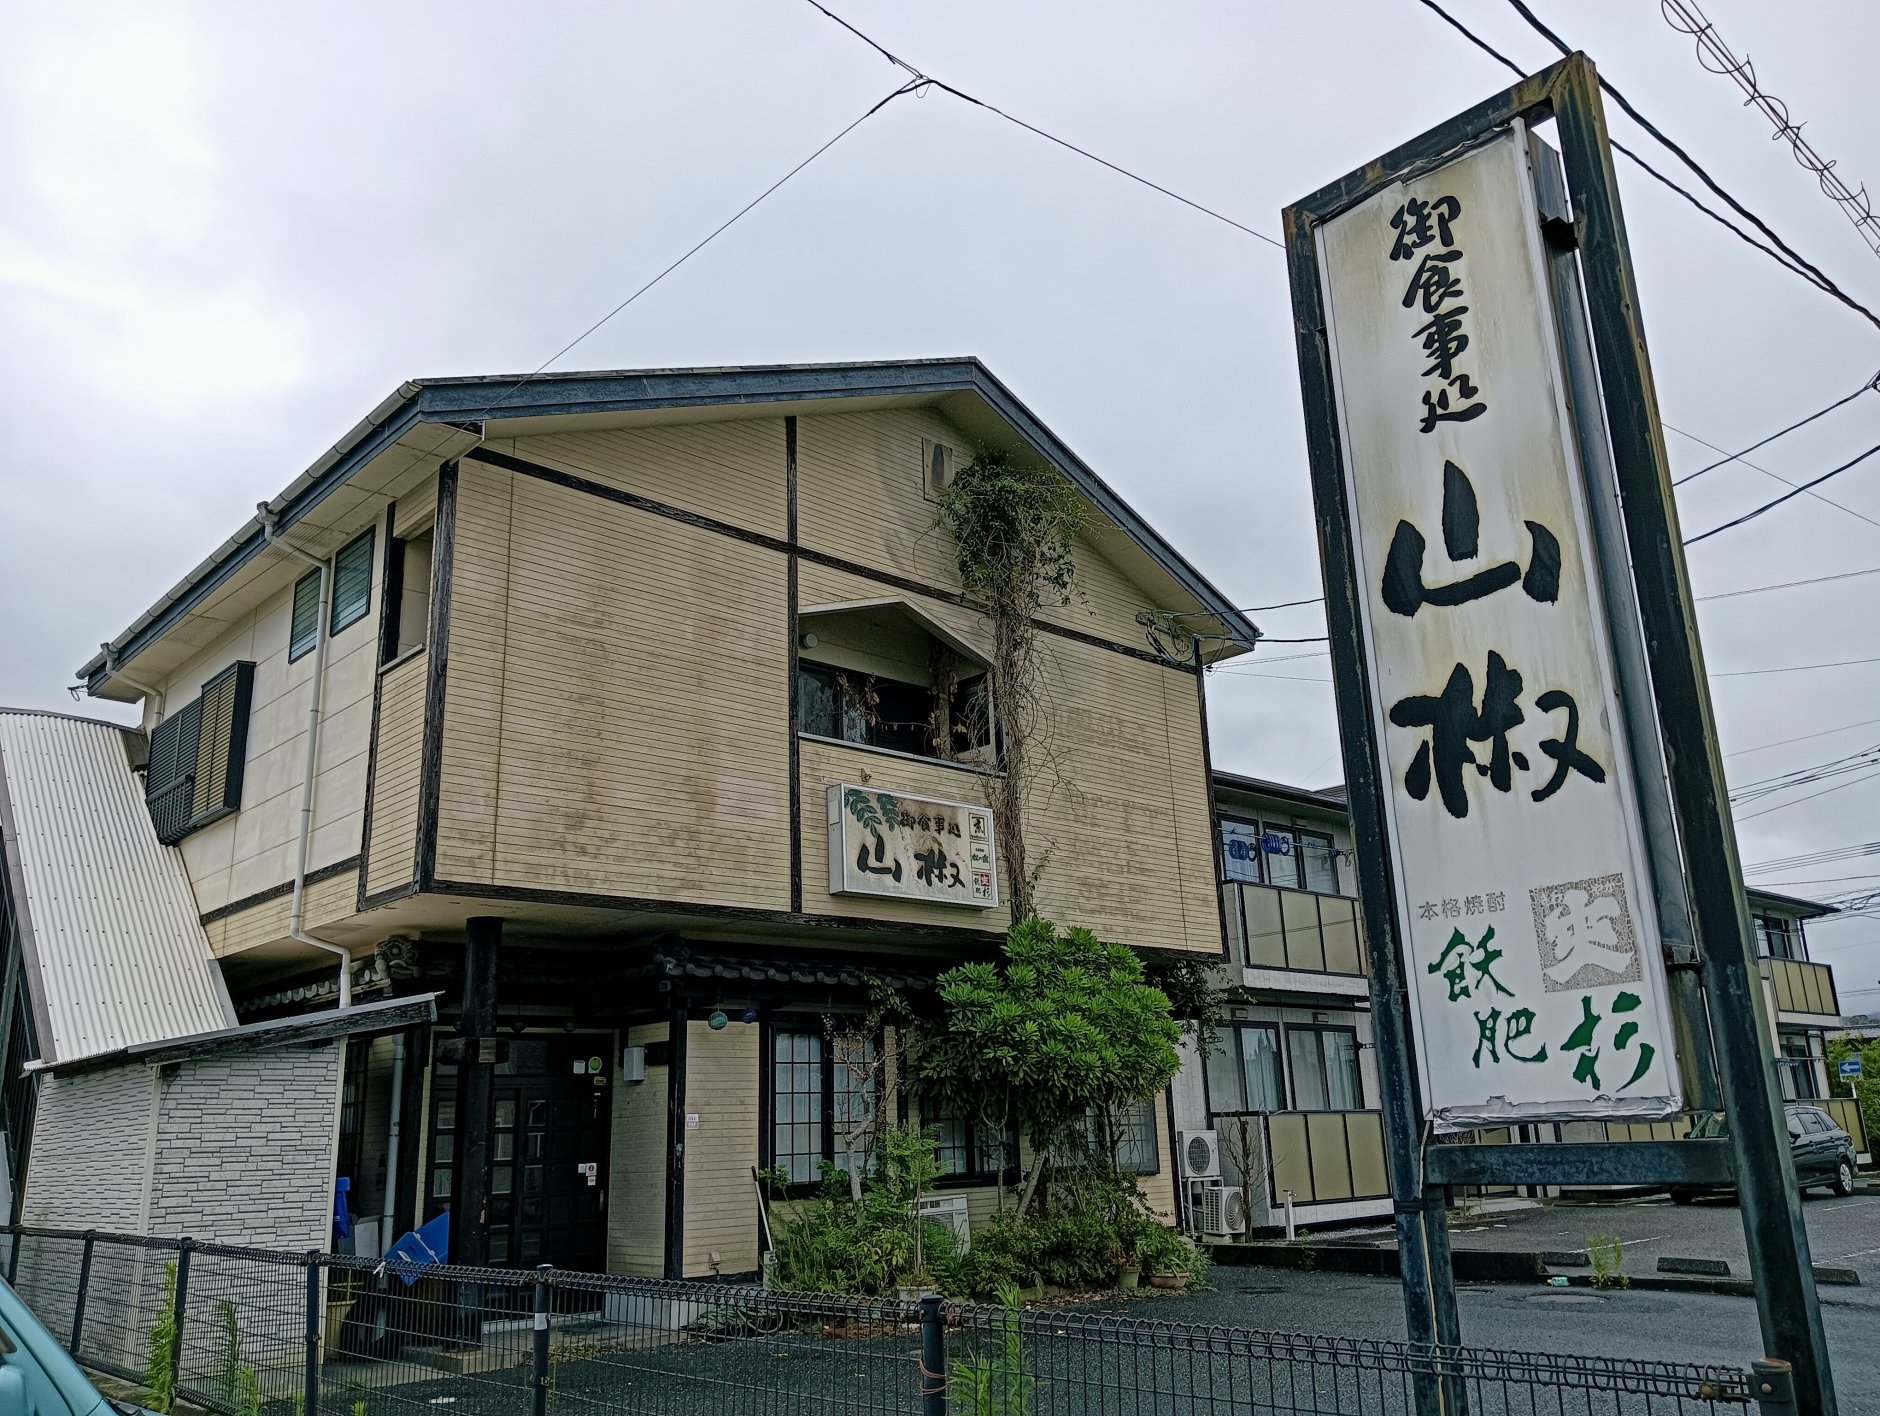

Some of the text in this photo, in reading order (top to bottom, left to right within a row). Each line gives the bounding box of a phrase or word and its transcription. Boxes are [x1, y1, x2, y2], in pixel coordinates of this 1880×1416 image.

[1389, 195, 1487, 434] 御食事処
[1382, 459, 1606, 819] 山椒
[900, 811, 962, 838] 御食事処
[857, 834, 965, 888] 山椒
[1418, 890, 1508, 922] 本格焼酎
